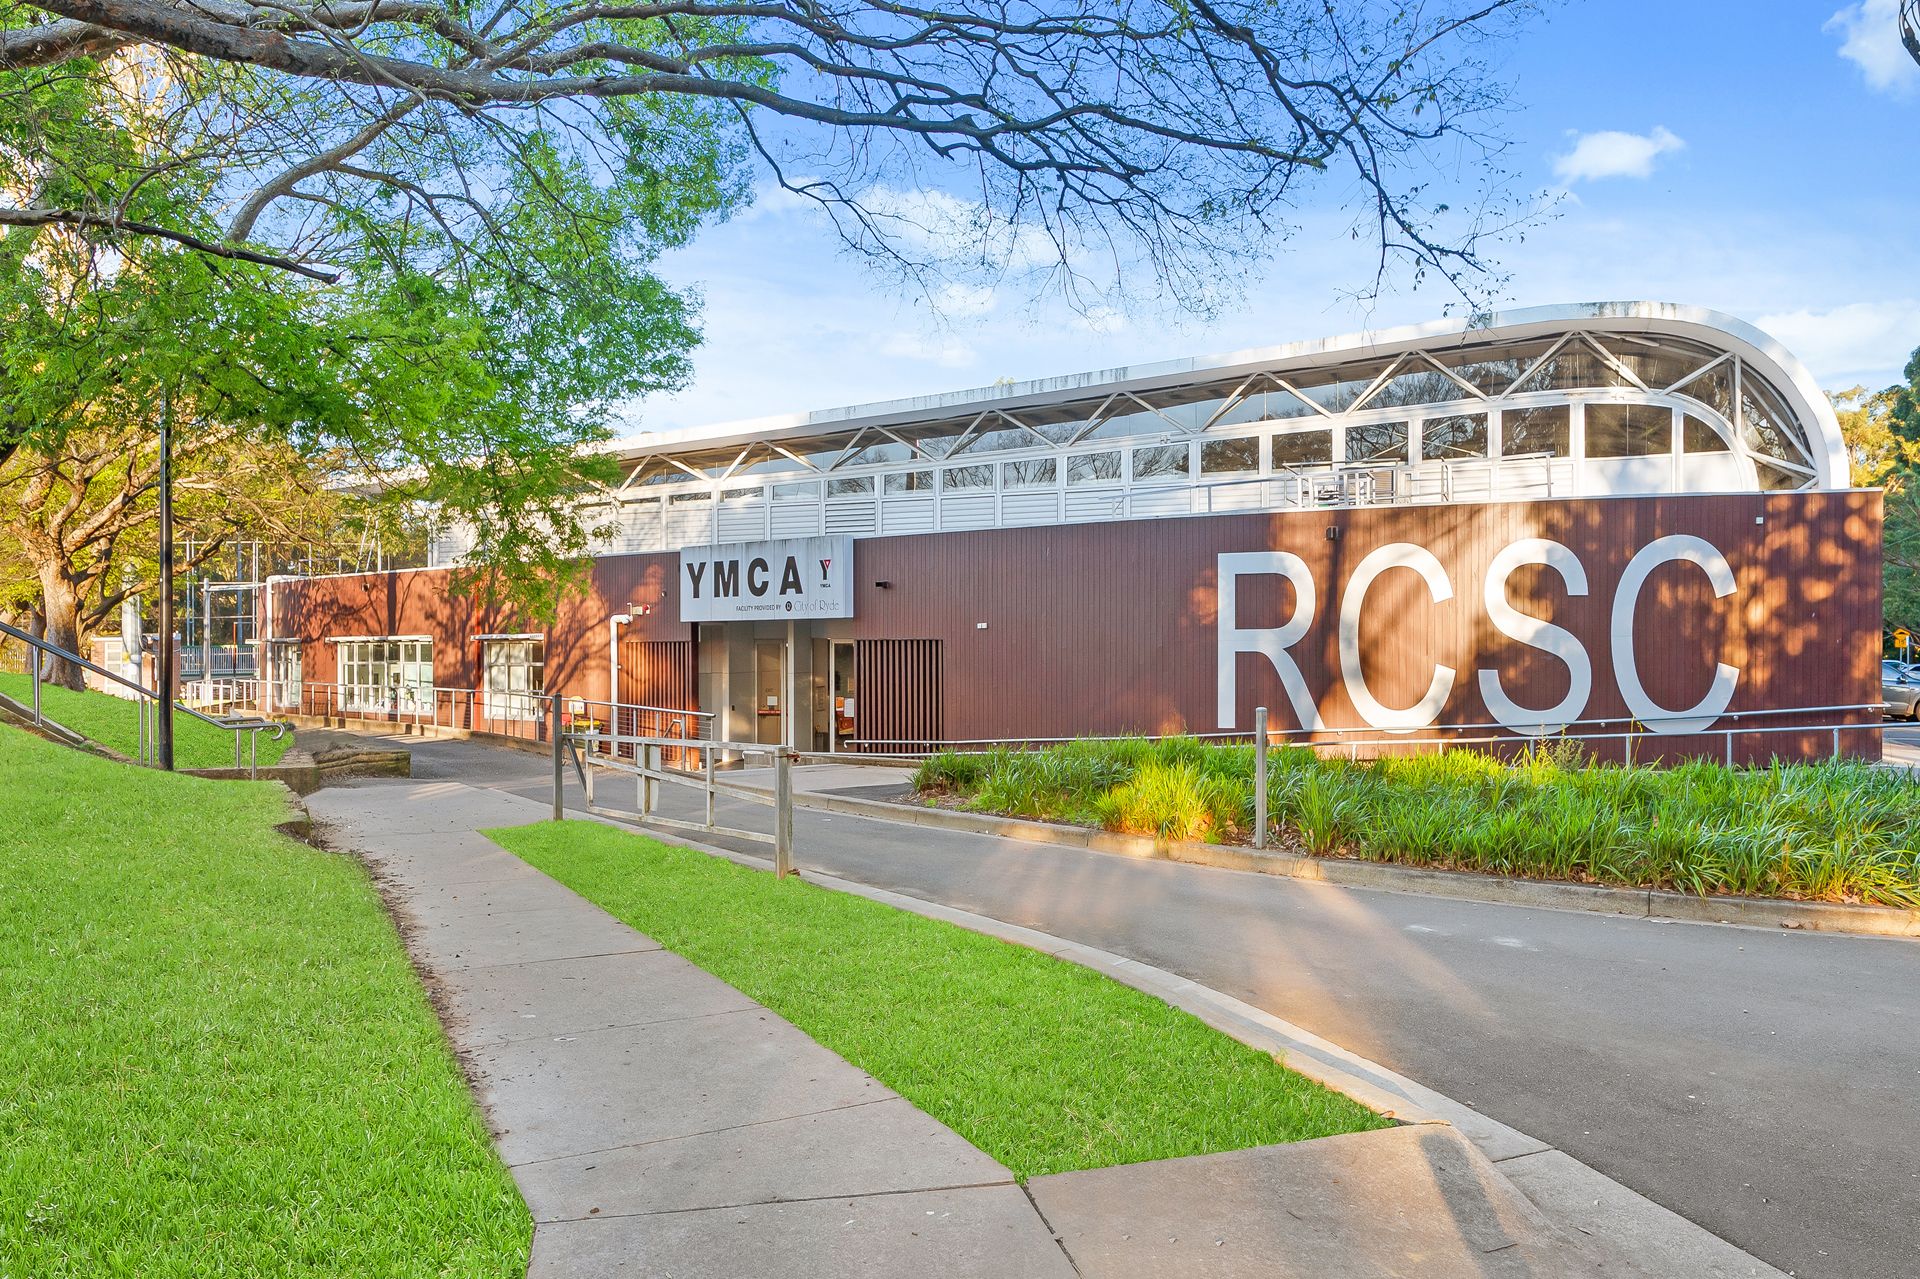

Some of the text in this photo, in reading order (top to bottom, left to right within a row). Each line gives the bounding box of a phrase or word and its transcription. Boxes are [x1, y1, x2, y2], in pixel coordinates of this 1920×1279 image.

[687, 556, 803, 598] YMCA
[794, 600, 839, 614] City of Ryde
[1217, 535, 1738, 735] RCSC
